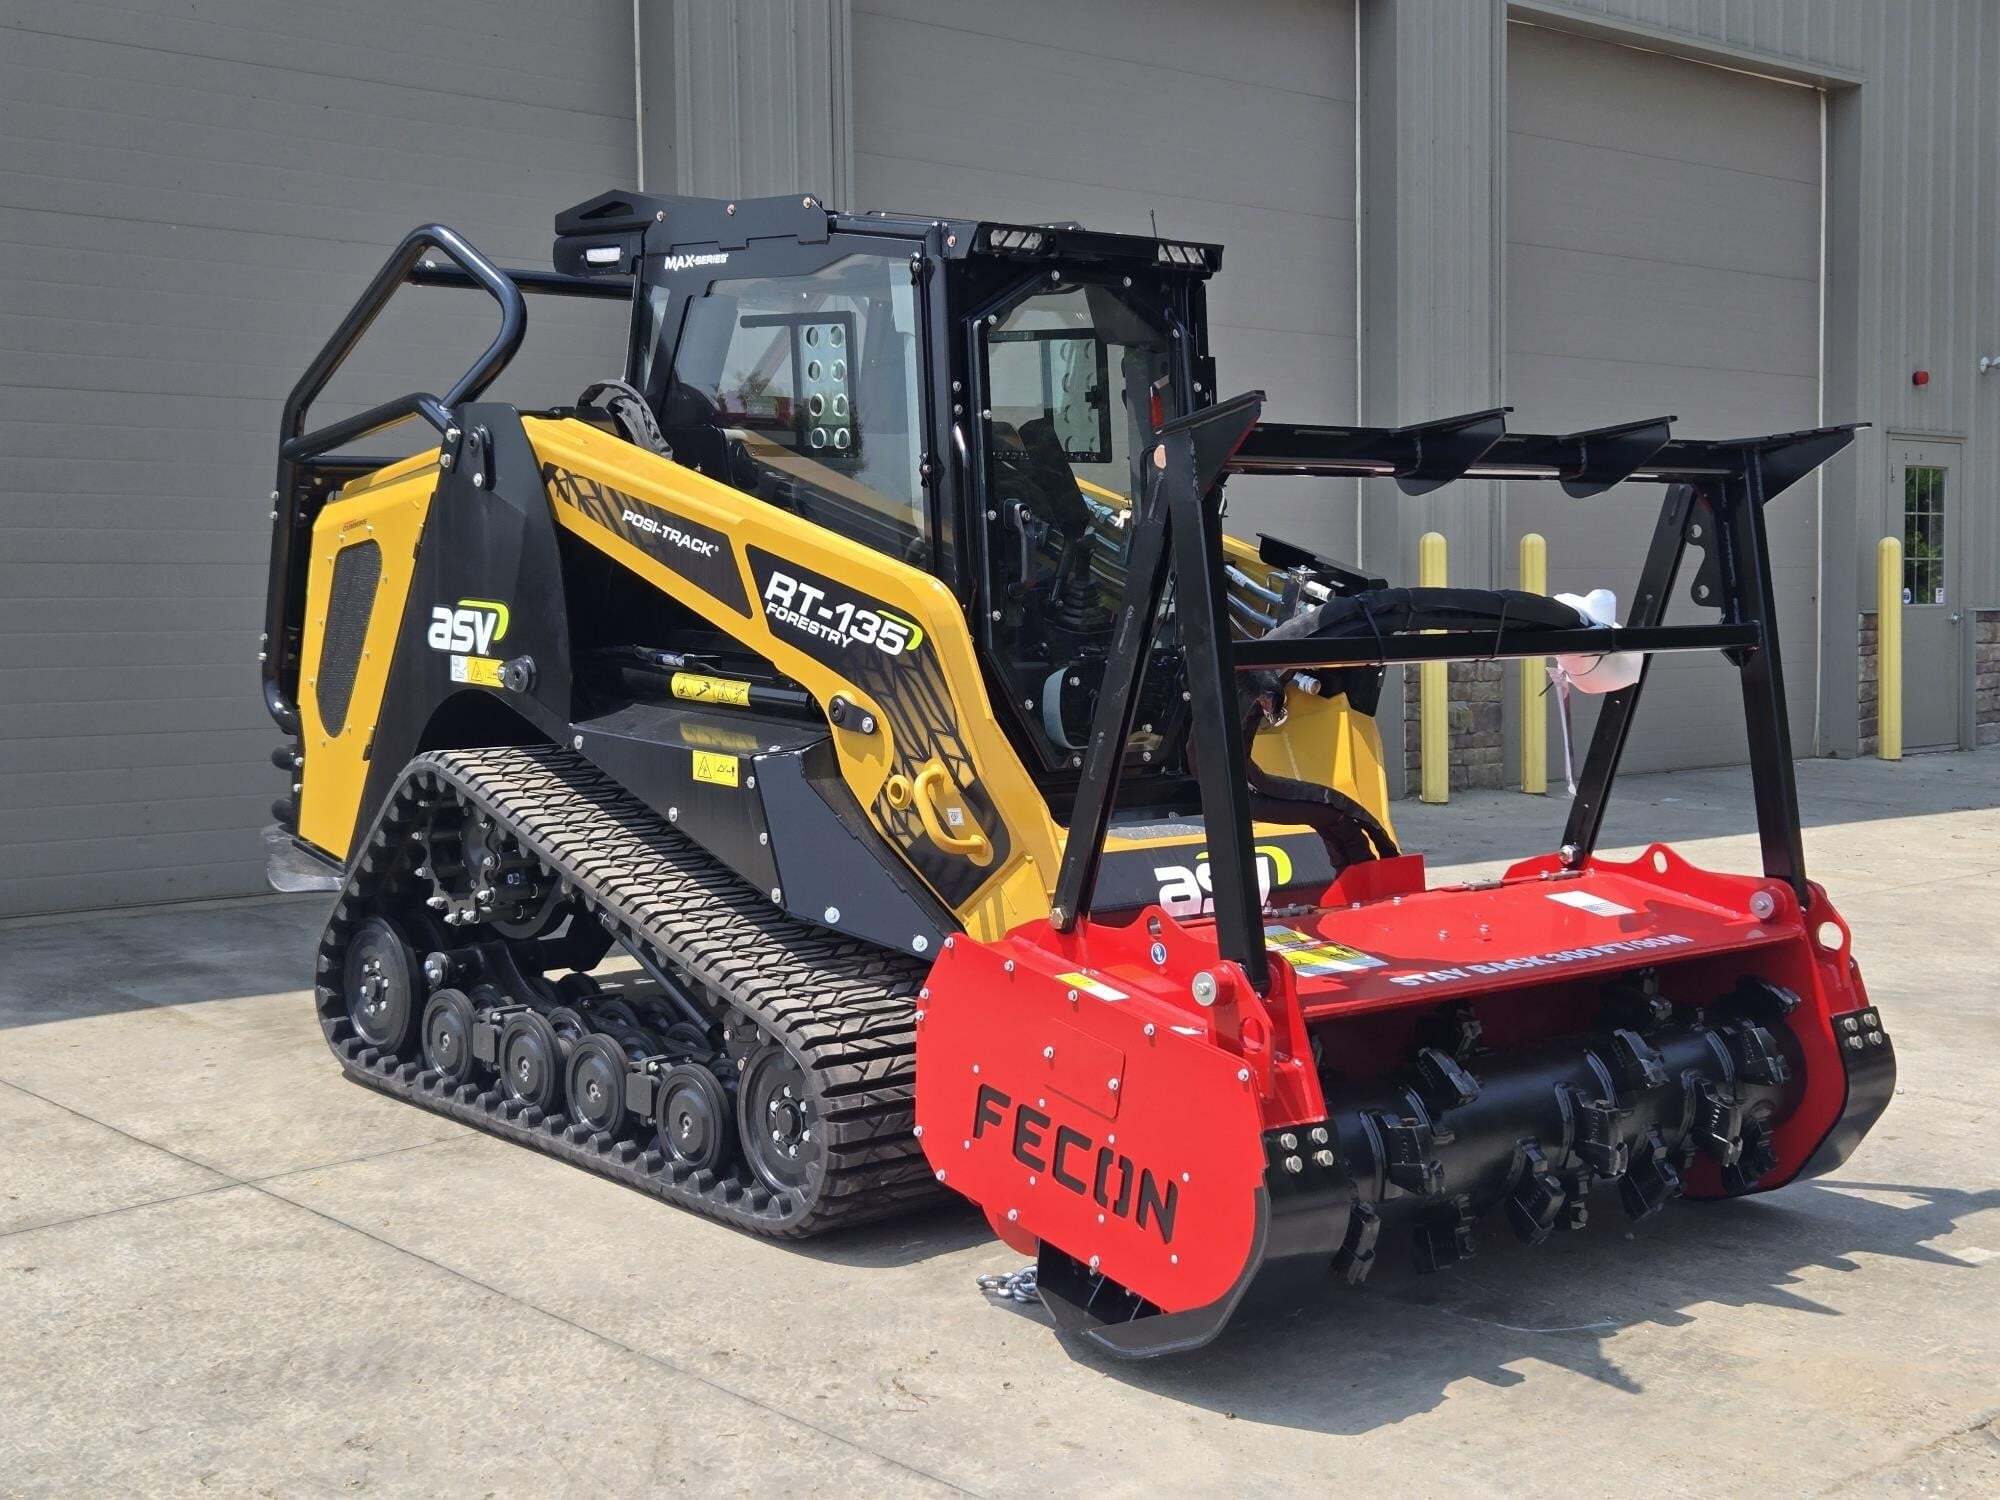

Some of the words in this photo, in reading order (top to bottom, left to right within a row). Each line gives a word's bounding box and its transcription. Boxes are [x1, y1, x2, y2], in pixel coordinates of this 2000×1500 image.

[428, 606, 497, 655] asv
[765, 570, 909, 656] RT-135
[765, 602, 853, 648] FORESTRY
[1389, 968, 1471, 986] STAY
[1465, 955, 1557, 974] BACK
[973, 1083, 1179, 1245] FECON
